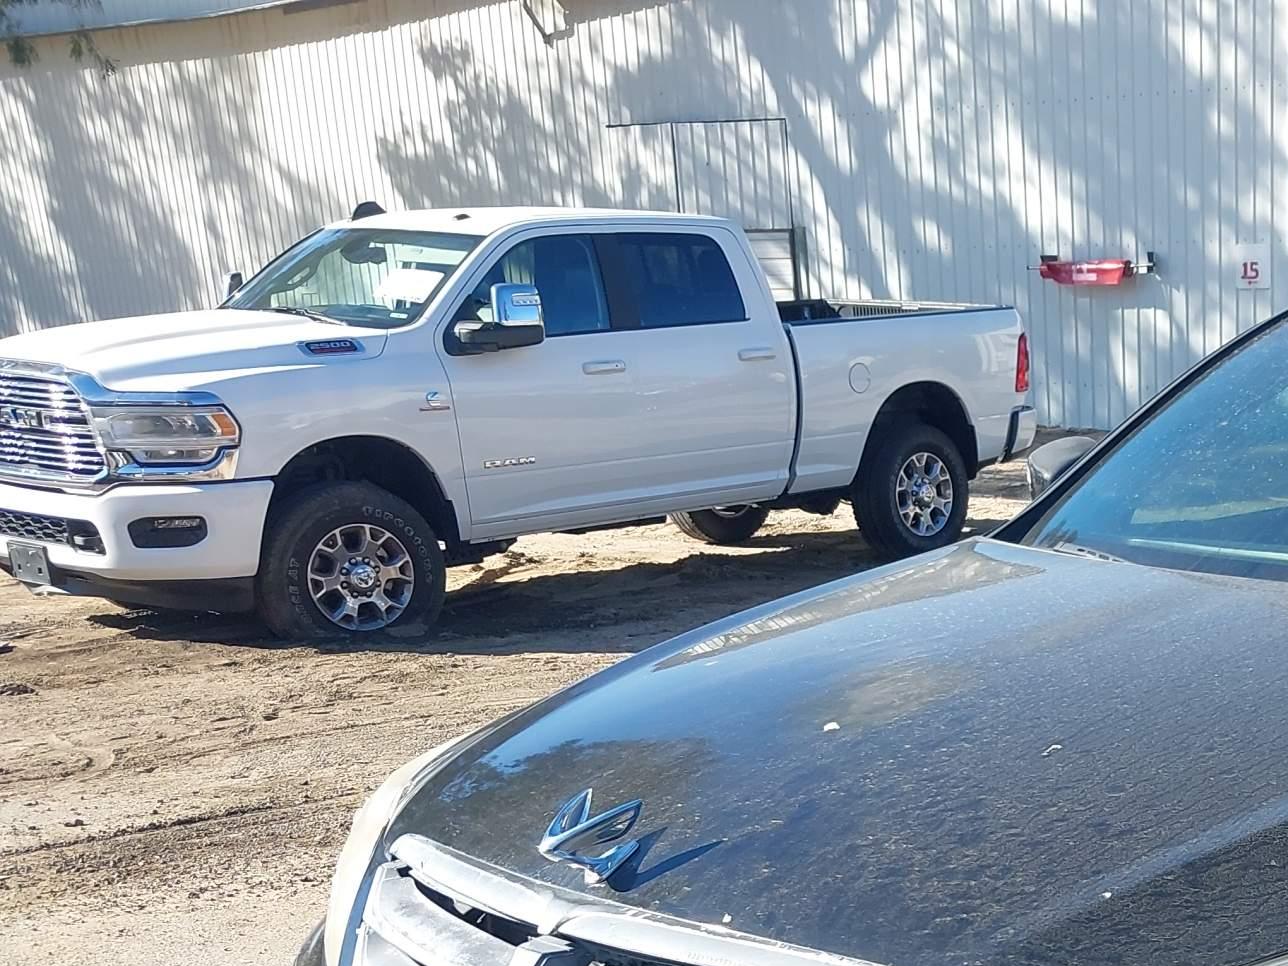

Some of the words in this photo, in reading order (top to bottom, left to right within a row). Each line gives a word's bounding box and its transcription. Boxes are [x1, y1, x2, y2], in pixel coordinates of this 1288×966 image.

[1241, 261, 1260, 280] 15
[309, 341, 351, 350] 2500
[483, 456, 536, 469] RAM
